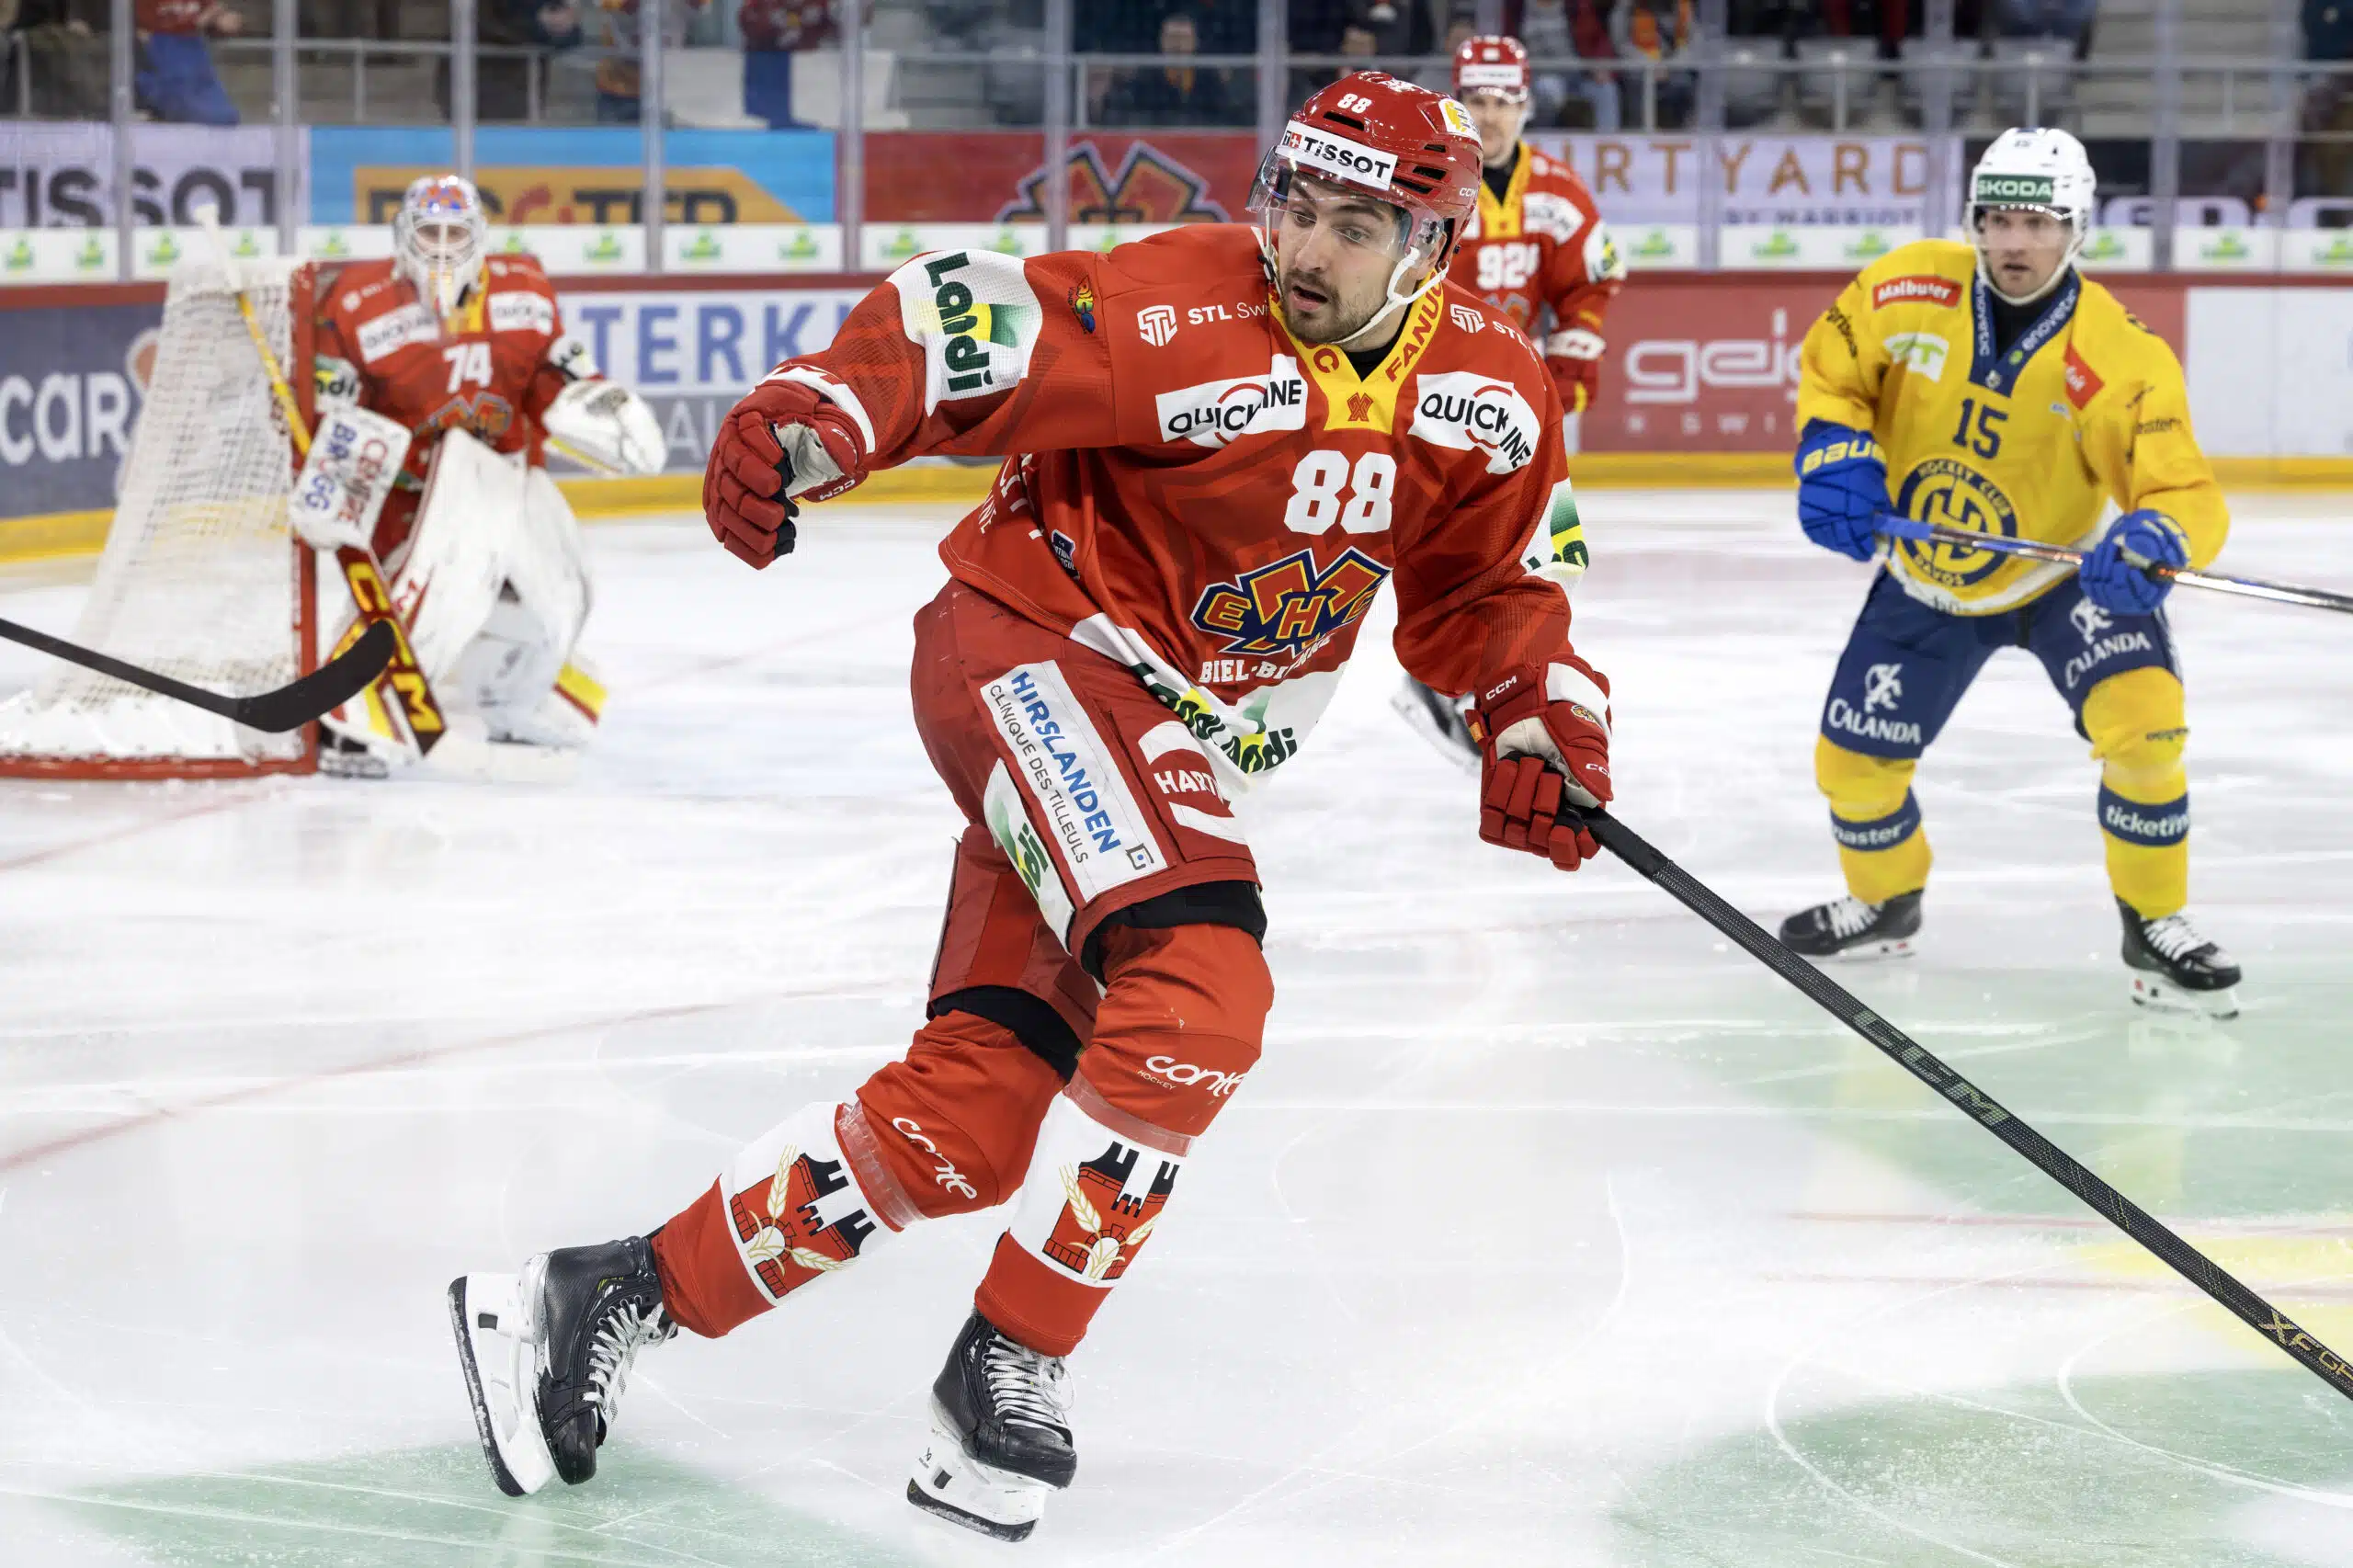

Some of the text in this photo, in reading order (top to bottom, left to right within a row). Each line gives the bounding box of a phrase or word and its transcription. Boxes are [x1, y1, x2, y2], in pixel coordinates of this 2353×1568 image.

[1337, 93, 1372, 114] 88
[1303, 137, 1392, 179] TISSOT
[1188, 309, 1233, 325] STL
[1236, 301, 1270, 319] Swi
[442, 341, 493, 394] 74
[579, 303, 860, 384] TERK
[1167, 379, 1302, 436] QUICKINE
[1420, 392, 1531, 470] QUICKINE
[1952, 397, 2009, 460] 15
[1283, 449, 1398, 536] 88
[1485, 674, 1518, 700] CCM
[1827, 698, 1922, 745] CALANDA
[989, 683, 1090, 865] CLINIQUE DES TILLEULS
[1010, 670, 1122, 856] HIRSLANDEN
[1153, 769, 1224, 806] HART
[1585, 762, 1611, 778] CC
[1136, 1069, 1177, 1091] HOCKEY
